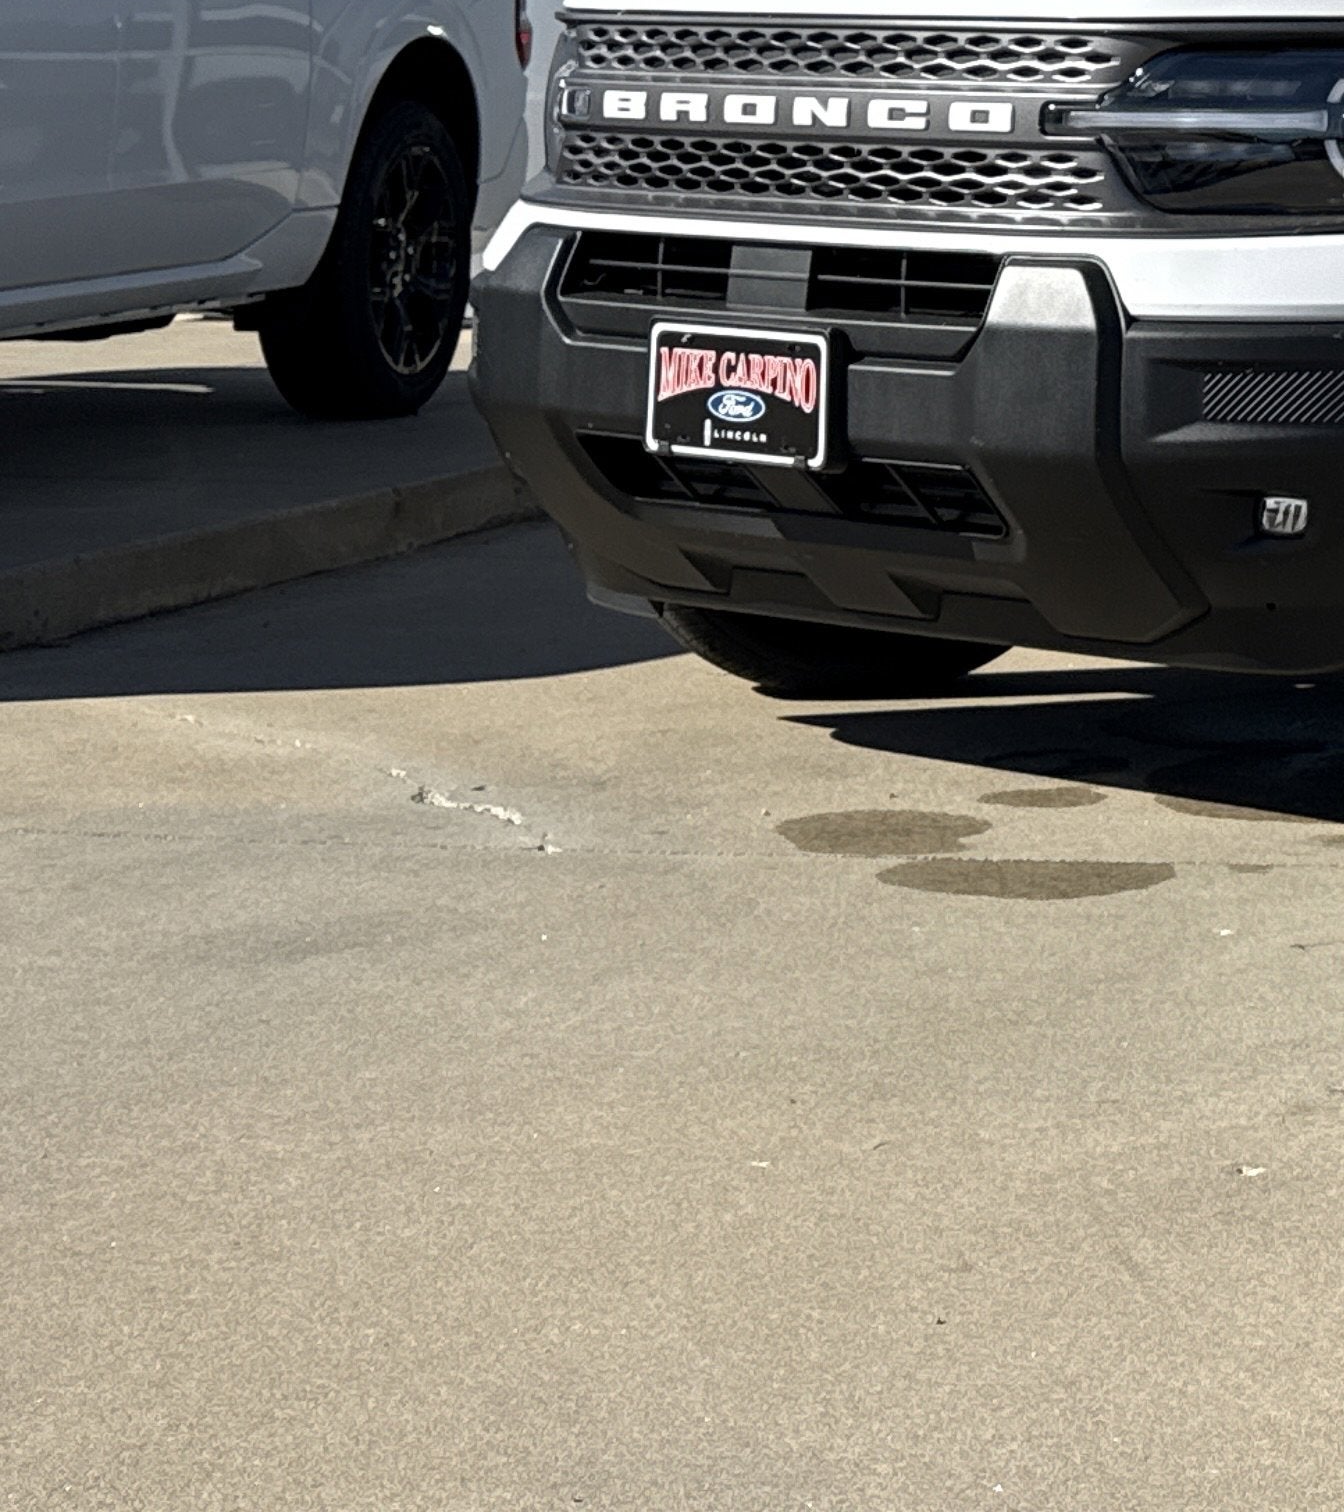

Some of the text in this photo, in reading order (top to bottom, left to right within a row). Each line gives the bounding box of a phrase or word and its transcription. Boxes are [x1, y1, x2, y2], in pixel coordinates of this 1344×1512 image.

[602, 89, 1013, 133] BRONCO
[657, 346, 817, 414] MIKE CARPINO
[717, 394, 755, 418] Ford
[713, 428, 768, 443] LINCOLN
